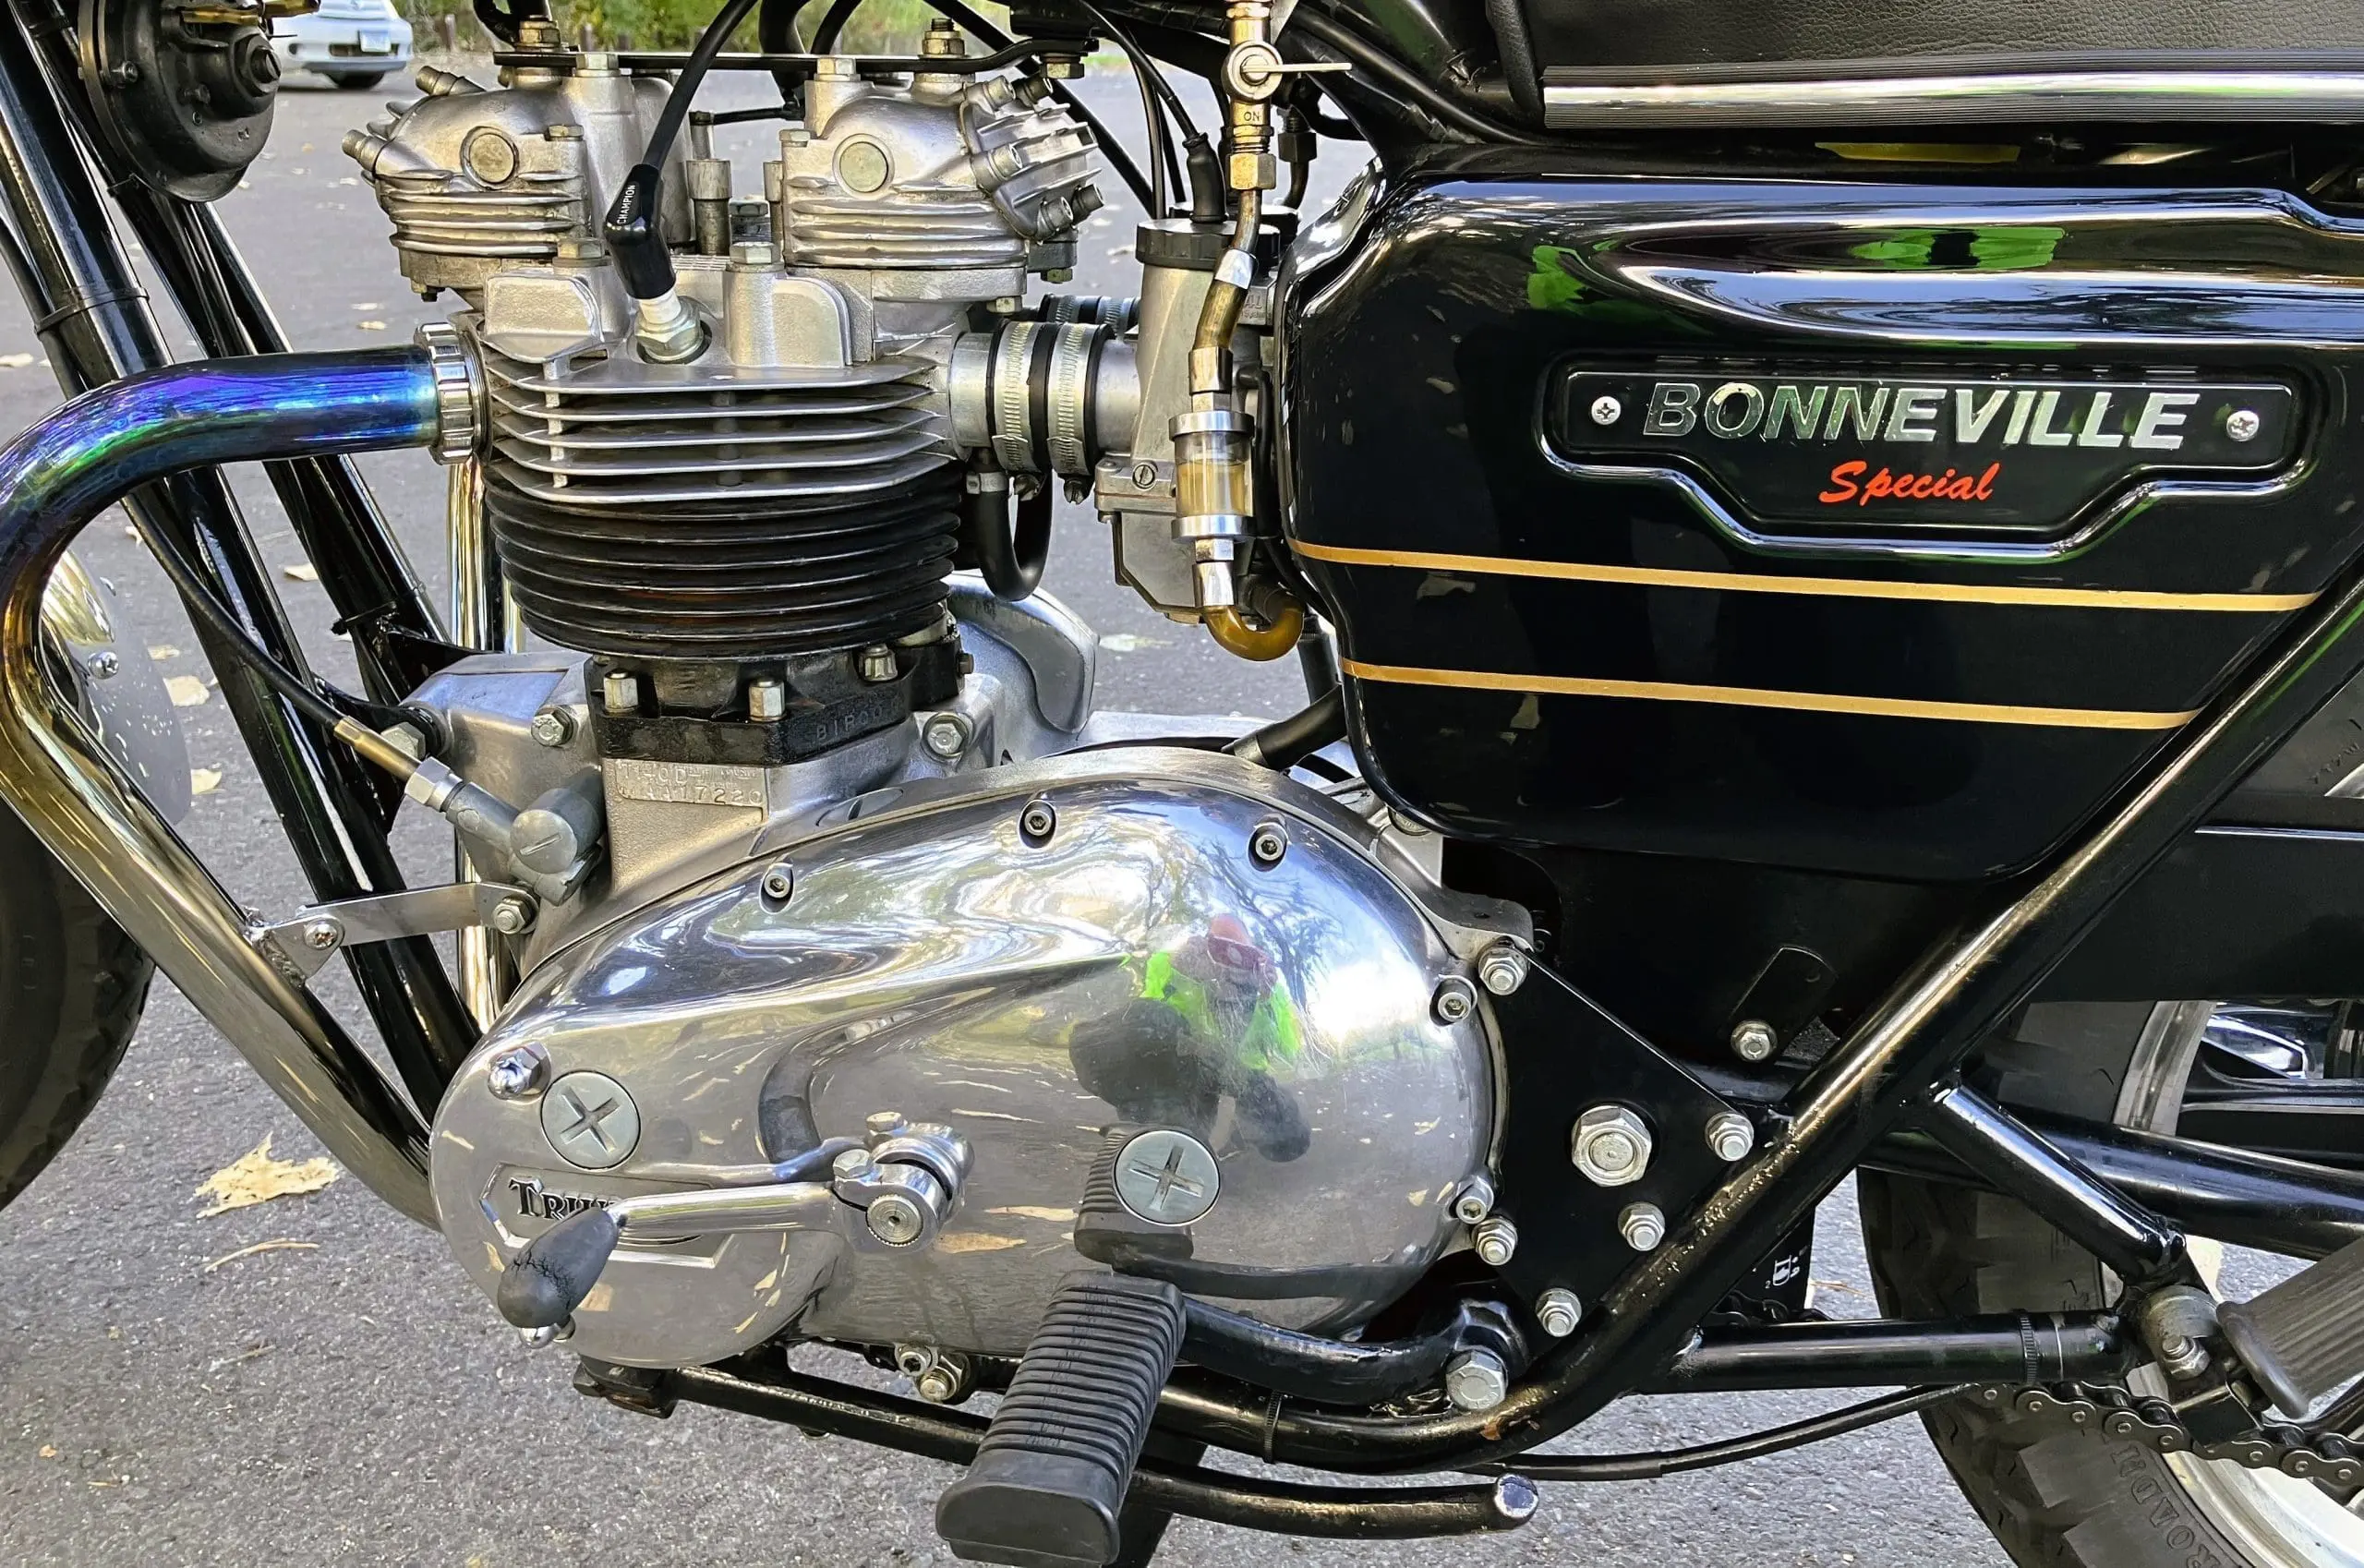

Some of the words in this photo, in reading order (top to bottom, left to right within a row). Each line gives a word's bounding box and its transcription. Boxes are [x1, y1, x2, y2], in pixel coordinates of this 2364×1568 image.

[1243, 111, 1261, 122] ON
[616, 185, 636, 224] CHAMPION
[1643, 381, 2201, 450] BONNEVILLE
[1818, 460, 2000, 507] Special
